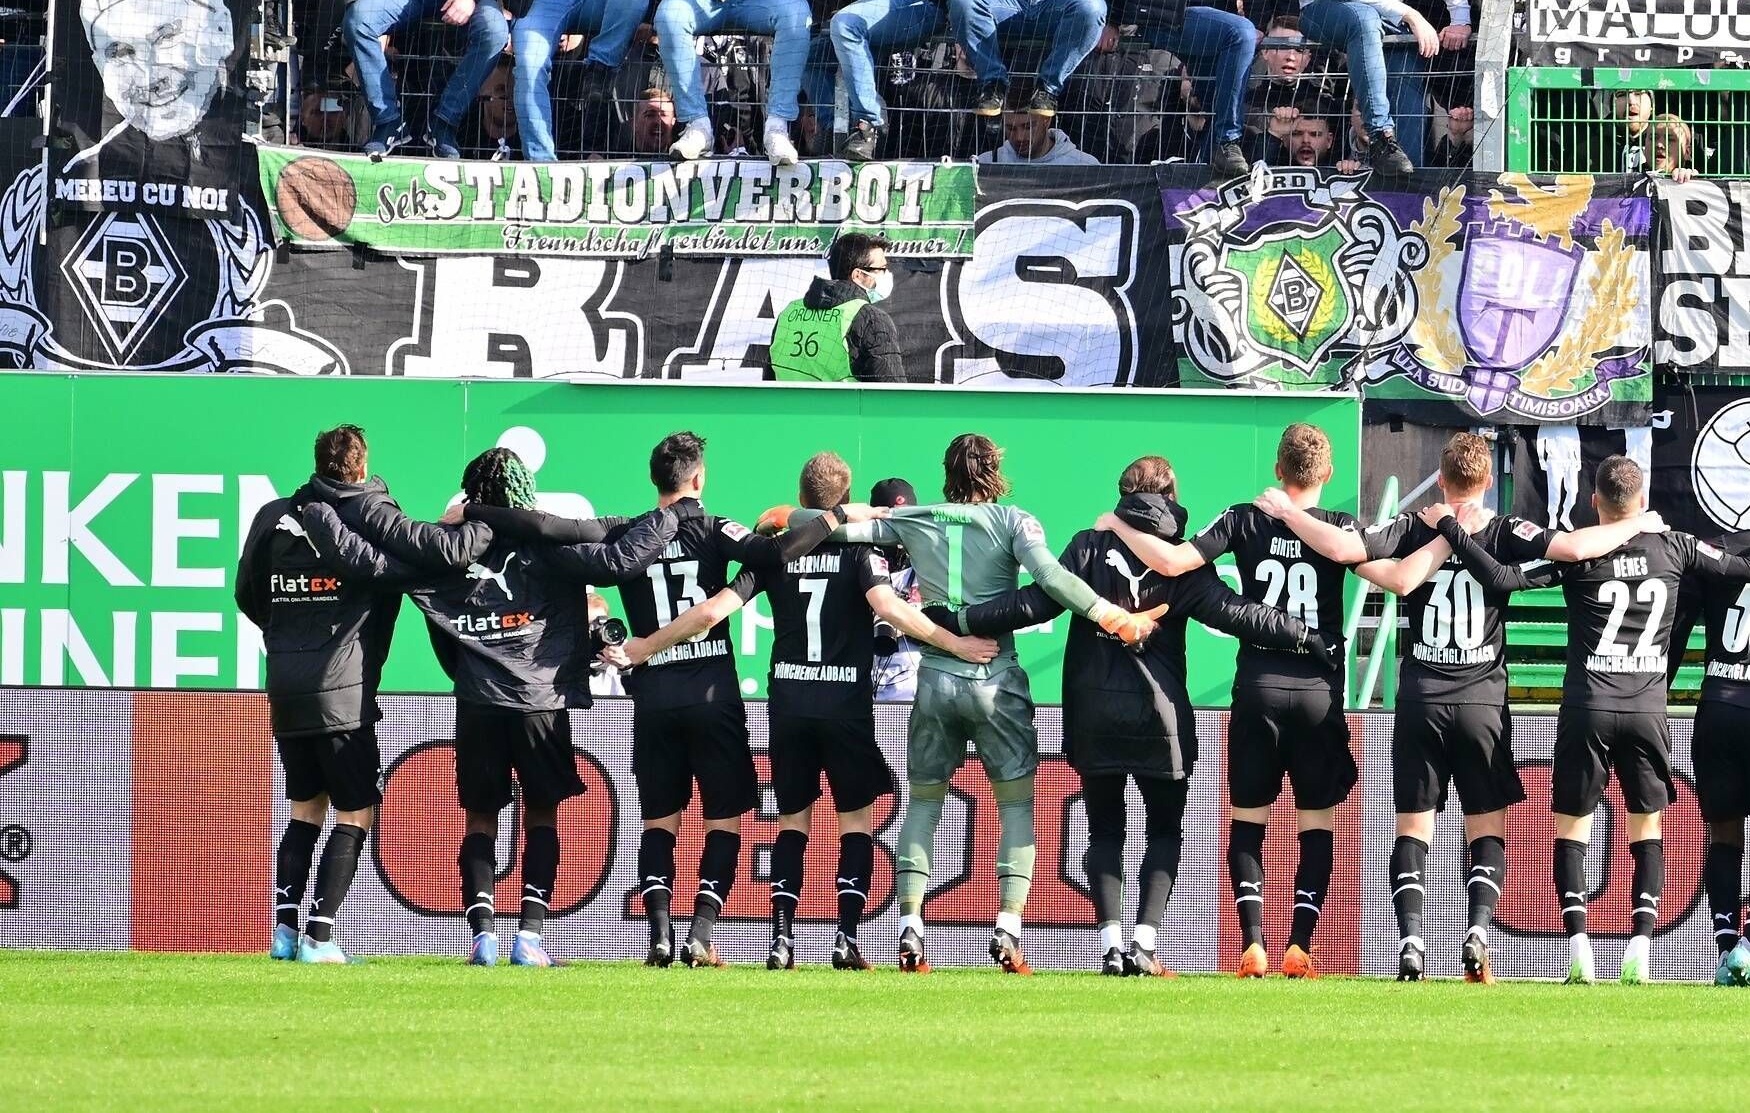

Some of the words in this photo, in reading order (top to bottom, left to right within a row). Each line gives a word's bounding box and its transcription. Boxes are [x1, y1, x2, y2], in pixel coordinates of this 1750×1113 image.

[55, 176, 137, 205] MEREU
[142, 182, 178, 208] CU
[181, 184, 229, 212] NOI
[423, 161, 936, 225] STADIONVERBOT
[1236, 173, 1308, 202] NRD
[777, 235, 821, 252] uns
[786, 306, 842, 325] ORDNER
[791, 330, 820, 359] 36
[1426, 372, 1467, 395] SUD
[1507, 384, 1609, 418] TIMISOARA
[1269, 536, 1302, 559] GINTER
[787, 555, 840, 574] HERRMANN
[945, 525, 964, 605] 1
[1613, 553, 1648, 579] BÉNES
[646, 560, 710, 645] 13
[1255, 558, 1319, 630] 28
[798, 578, 829, 663] 7
[1421, 568, 1486, 650] 30
[1594, 578, 1670, 657] 22
[1412, 642, 1496, 666] MÖNCHENGLADBACH
[774, 662, 857, 684] MÖNCHENGLADBACH
